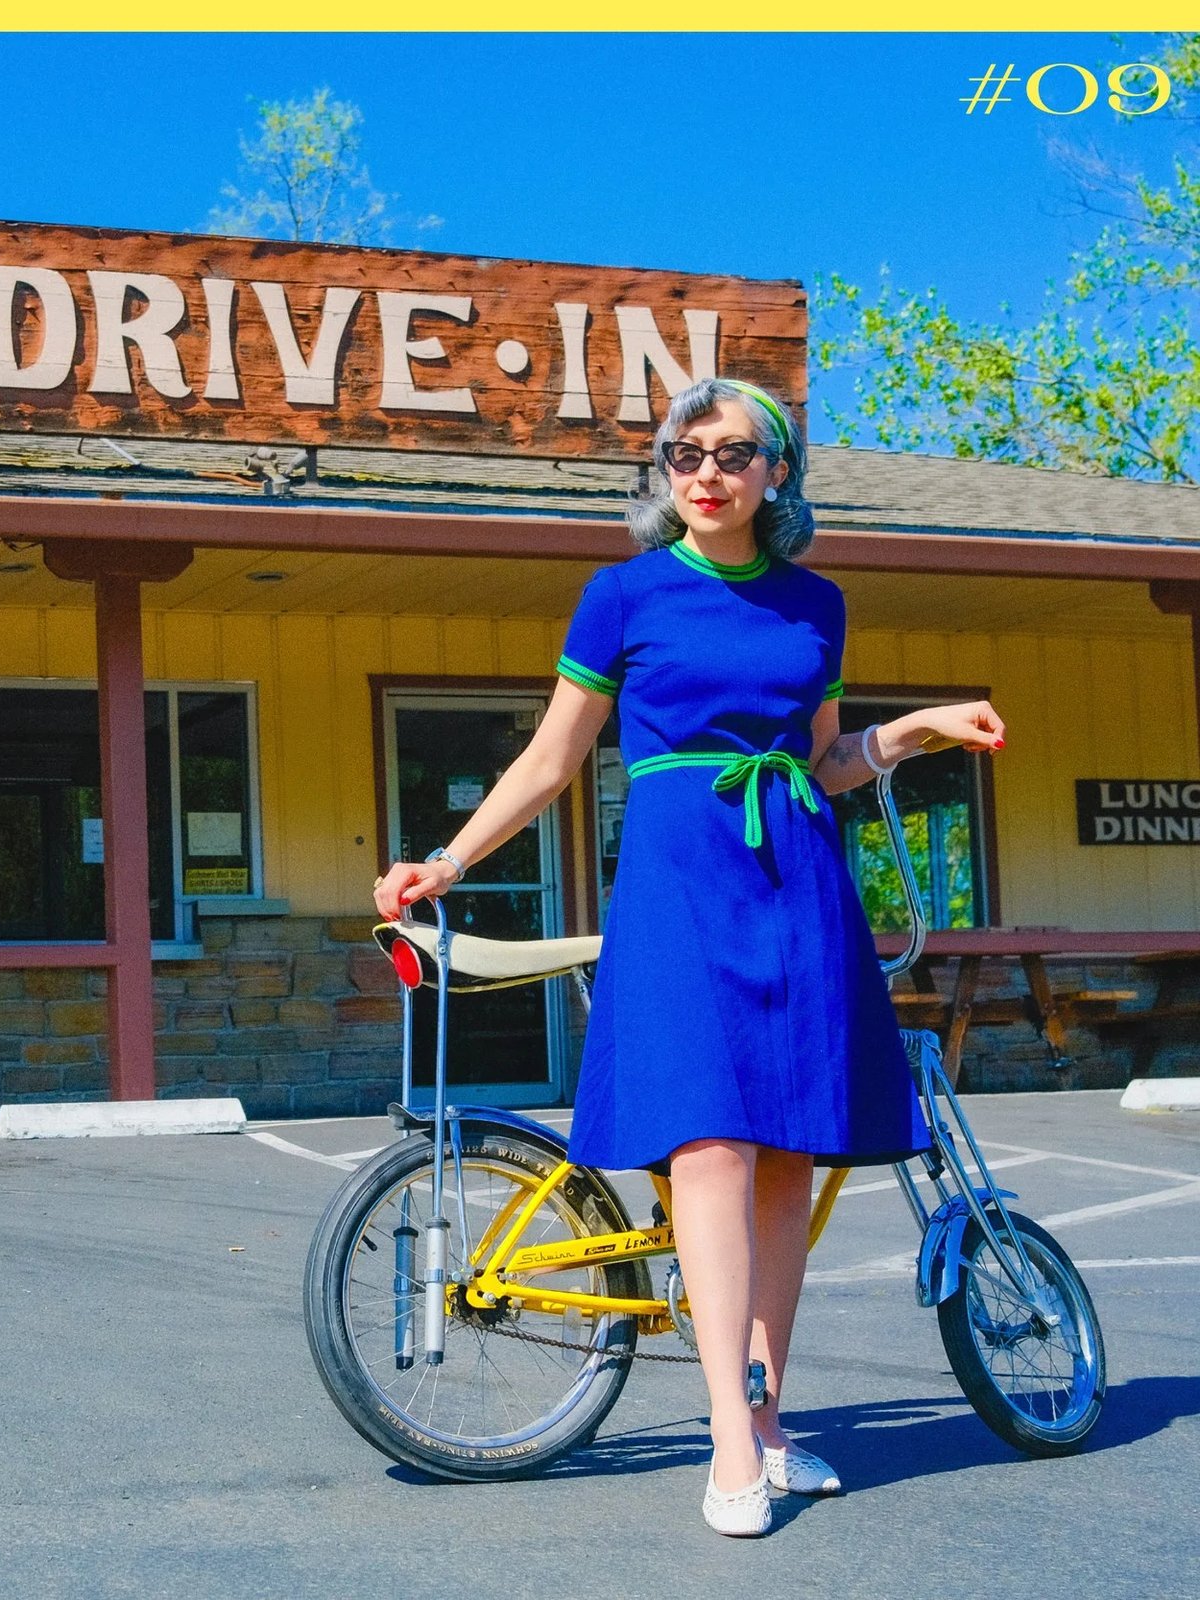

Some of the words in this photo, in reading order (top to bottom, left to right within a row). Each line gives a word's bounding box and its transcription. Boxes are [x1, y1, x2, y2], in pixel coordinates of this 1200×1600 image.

[497, 1147, 529, 1165] WIDE
[535, 1162, 574, 1196] TRD
[517, 1252, 575, 1265] Schwinn
[625, 1235, 661, 1250] LEMON
[482, 1440, 539, 1459] SCHWINN
